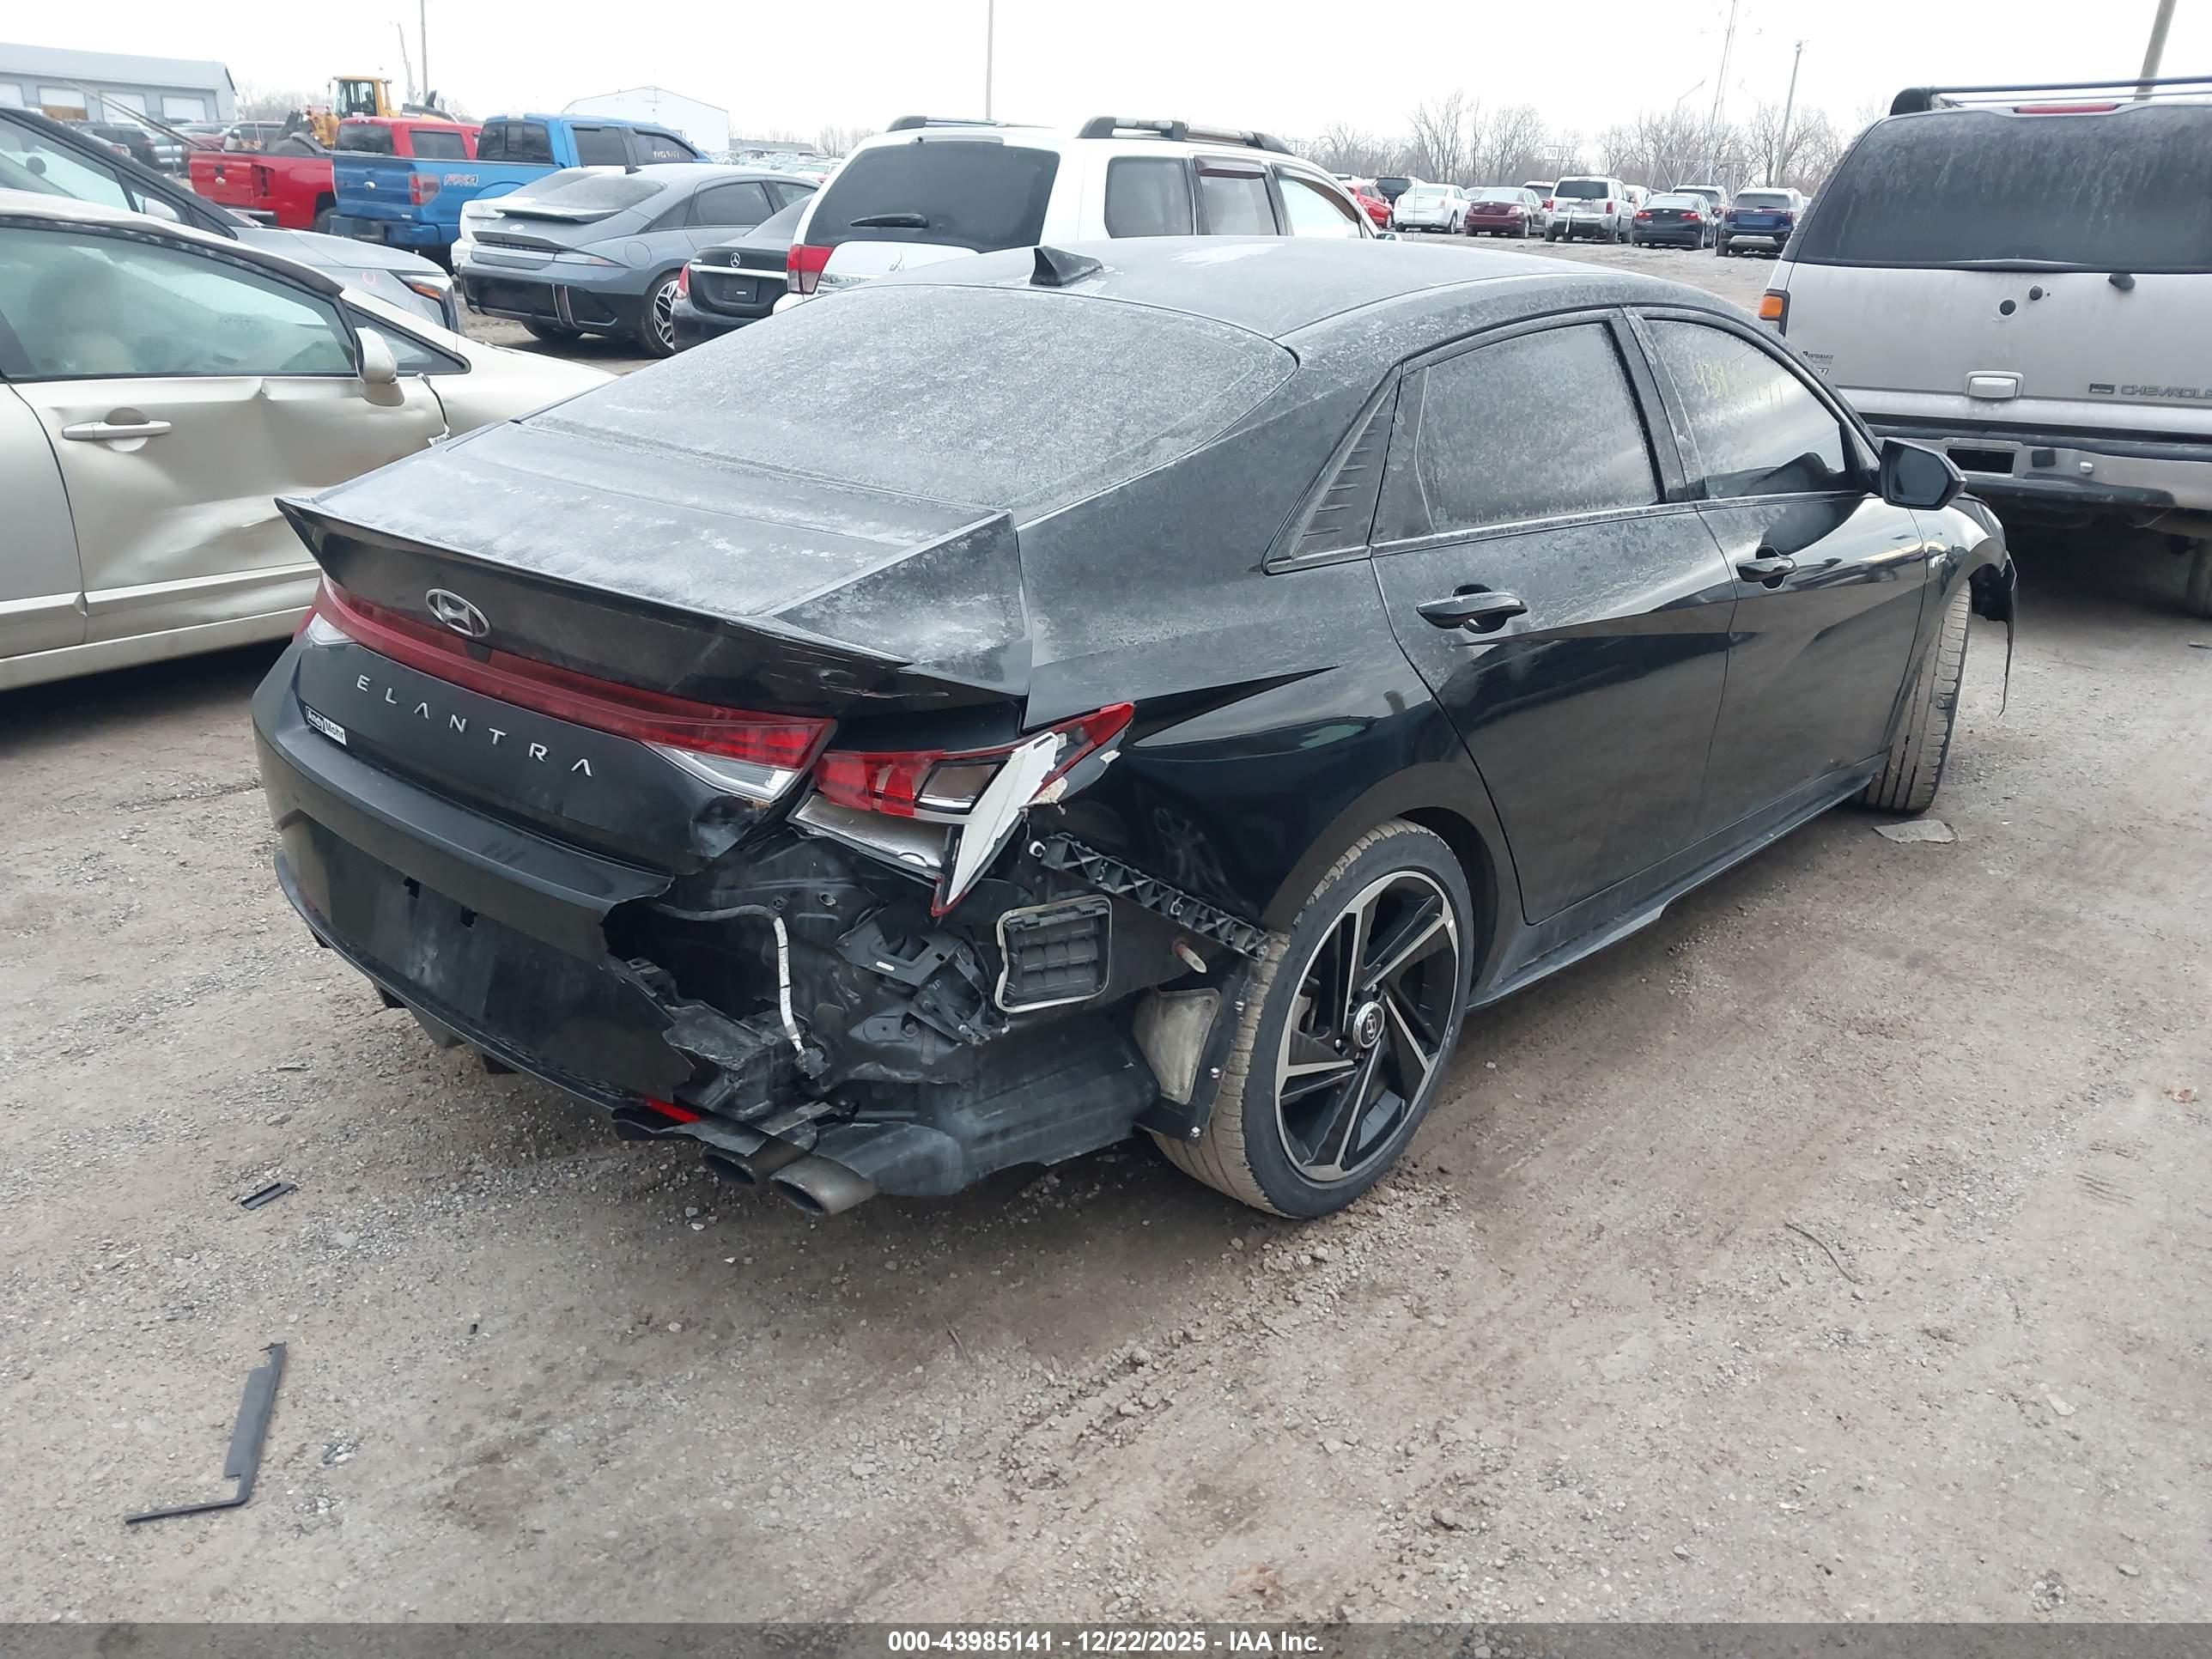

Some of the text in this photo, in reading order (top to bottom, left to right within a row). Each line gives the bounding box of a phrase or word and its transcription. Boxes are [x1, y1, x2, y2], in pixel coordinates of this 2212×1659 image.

[307, 709, 344, 739] Andy Mohr
[356, 673, 593, 777] ELANTRA
